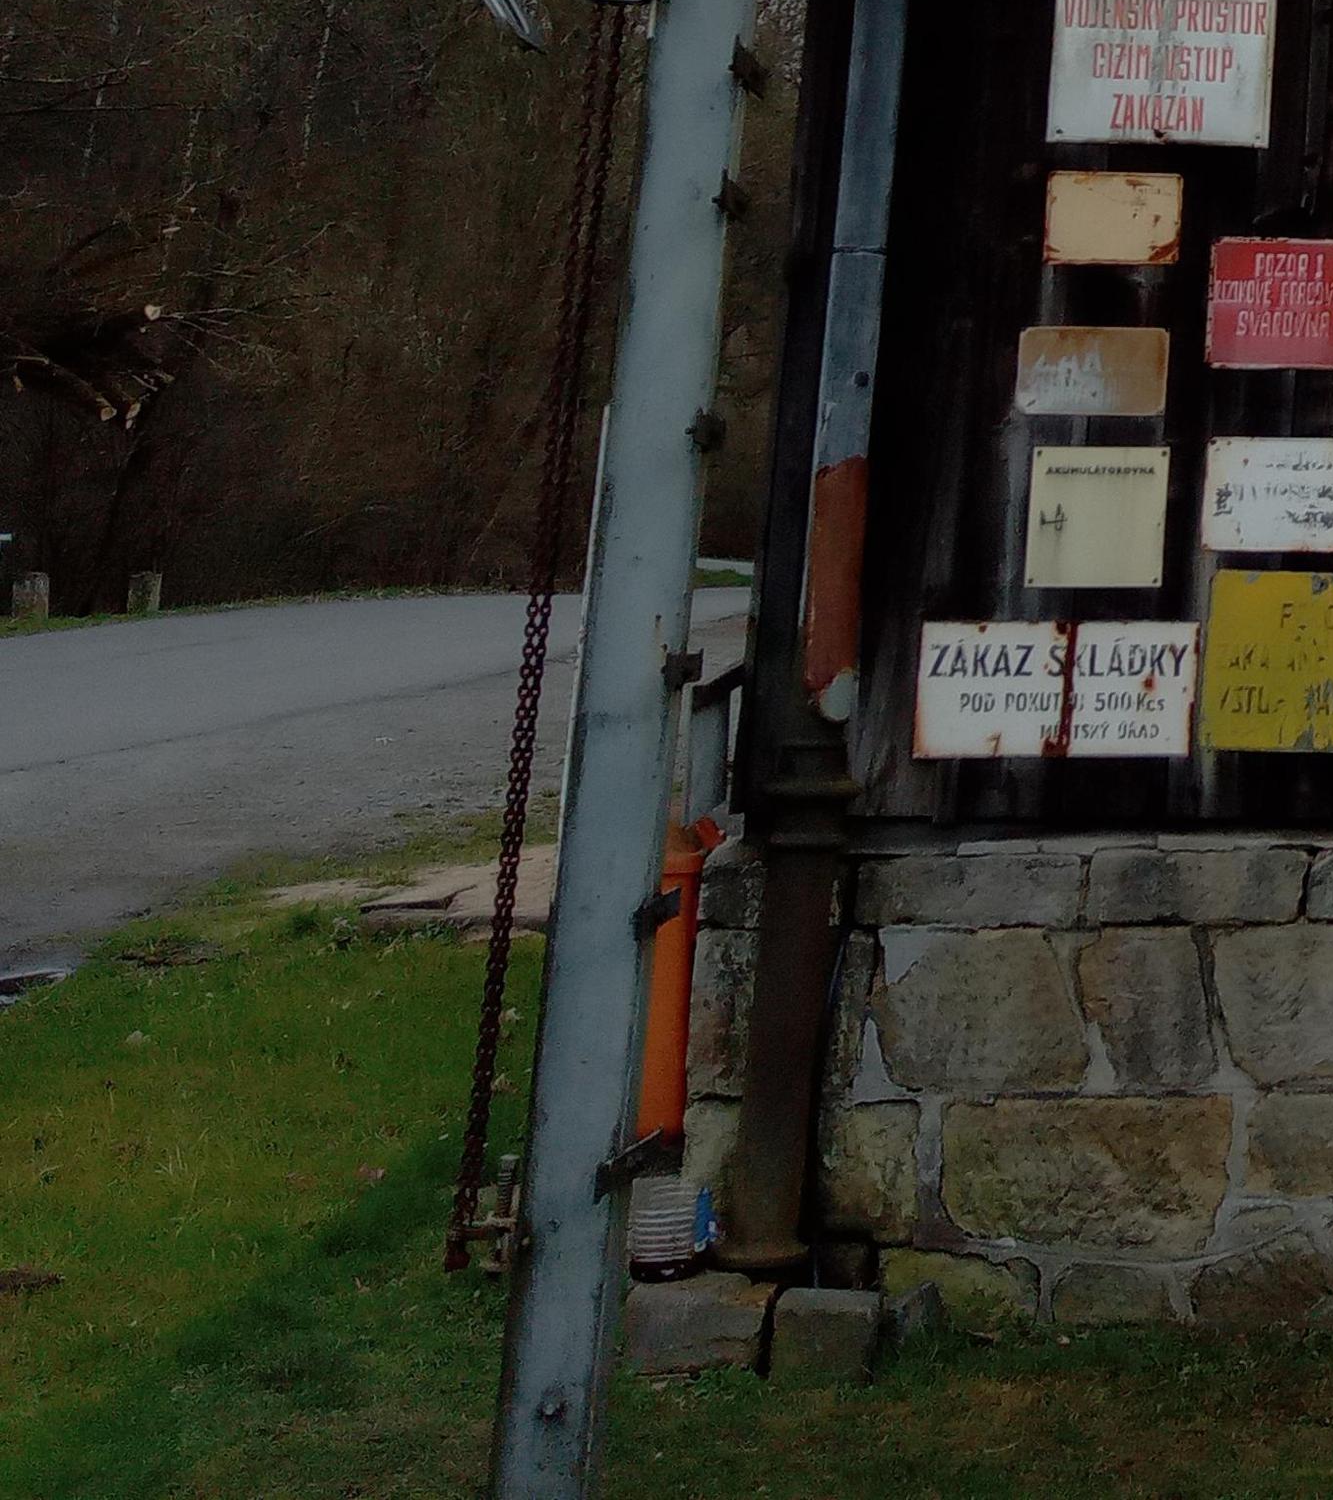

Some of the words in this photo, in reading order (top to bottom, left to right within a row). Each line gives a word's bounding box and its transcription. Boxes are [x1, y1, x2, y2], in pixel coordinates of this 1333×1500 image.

[1092, 40, 1150, 79] CIZÍM
[1162, 47, 1233, 83] VSTUP
[1109, 85, 1204, 132] ZAKÁZÁN
